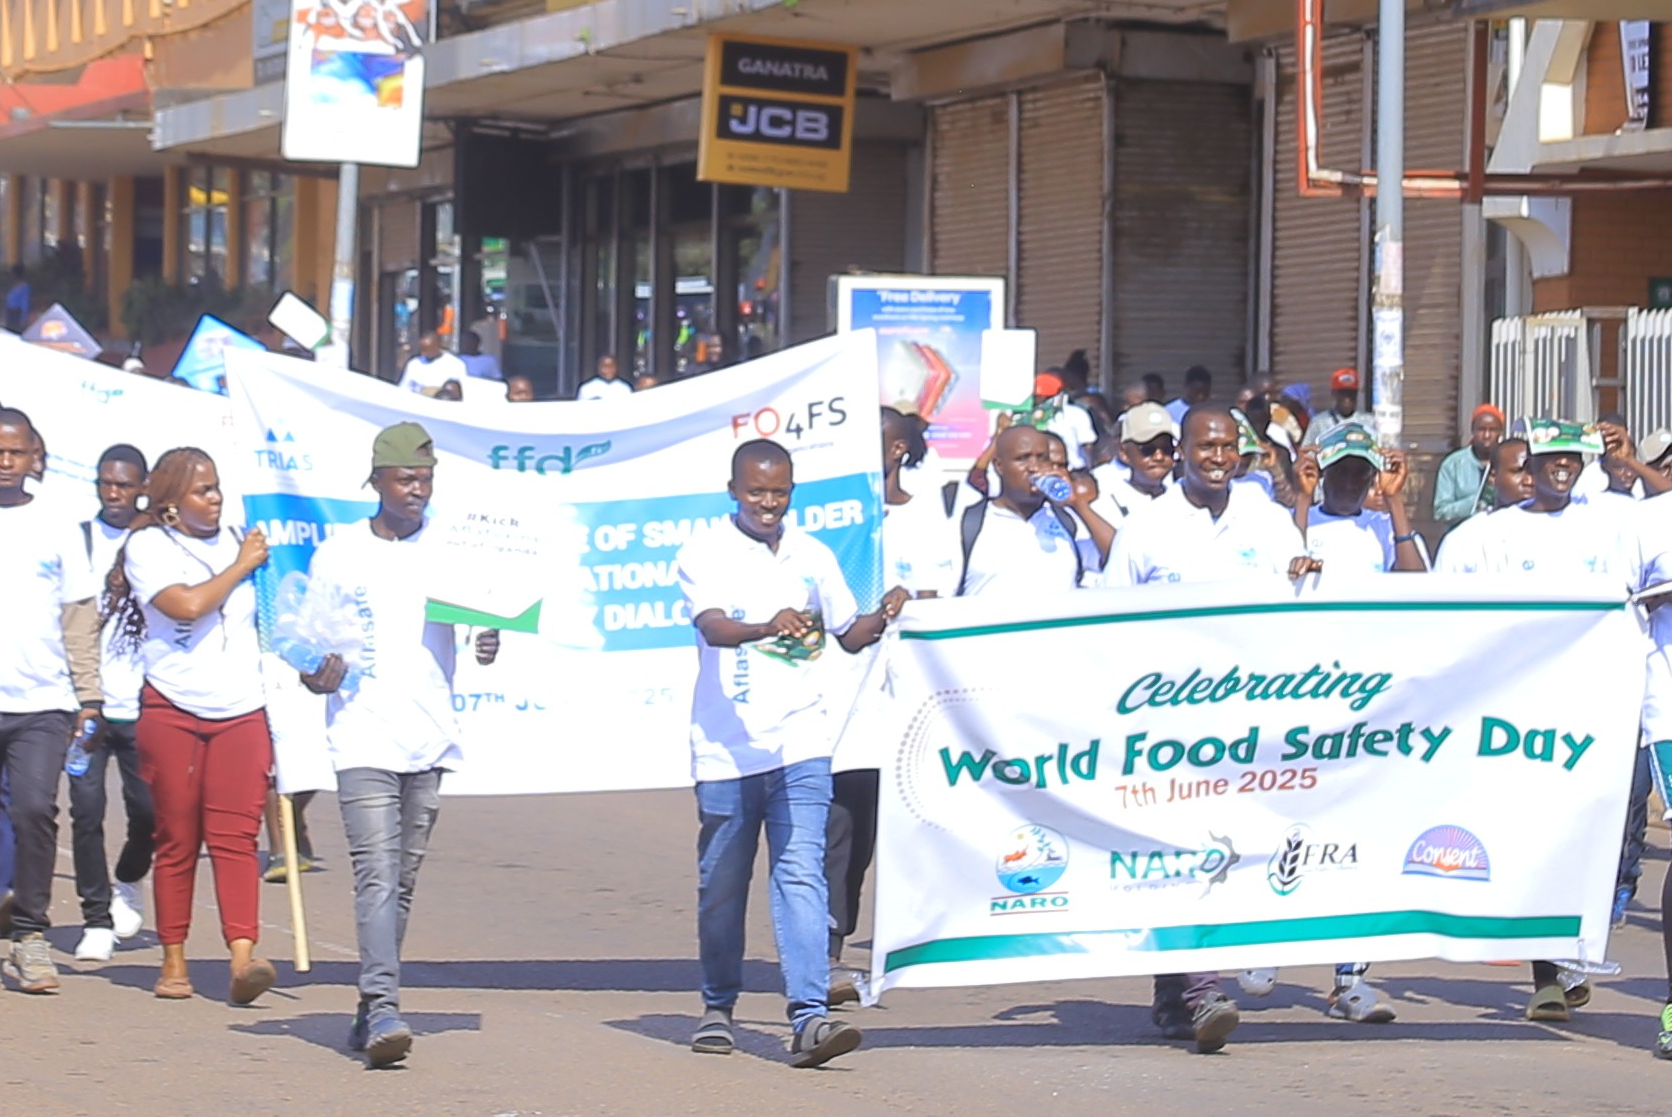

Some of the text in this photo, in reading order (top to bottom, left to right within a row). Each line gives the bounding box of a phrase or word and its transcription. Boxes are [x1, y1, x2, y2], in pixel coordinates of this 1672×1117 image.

[737, 56, 829, 81] GANATRA
[729, 104, 830, 142] JCB
[254, 449, 314, 472] TRIAS
[593, 521, 637, 553] OF
[1115, 660, 1393, 716] Celebrating
[938, 715, 1595, 789] World Food Safety Day
[1114, 767, 1319, 809] 7th June 2025
[1411, 838, 1480, 870] Consent
[989, 896, 1069, 913] NARO
